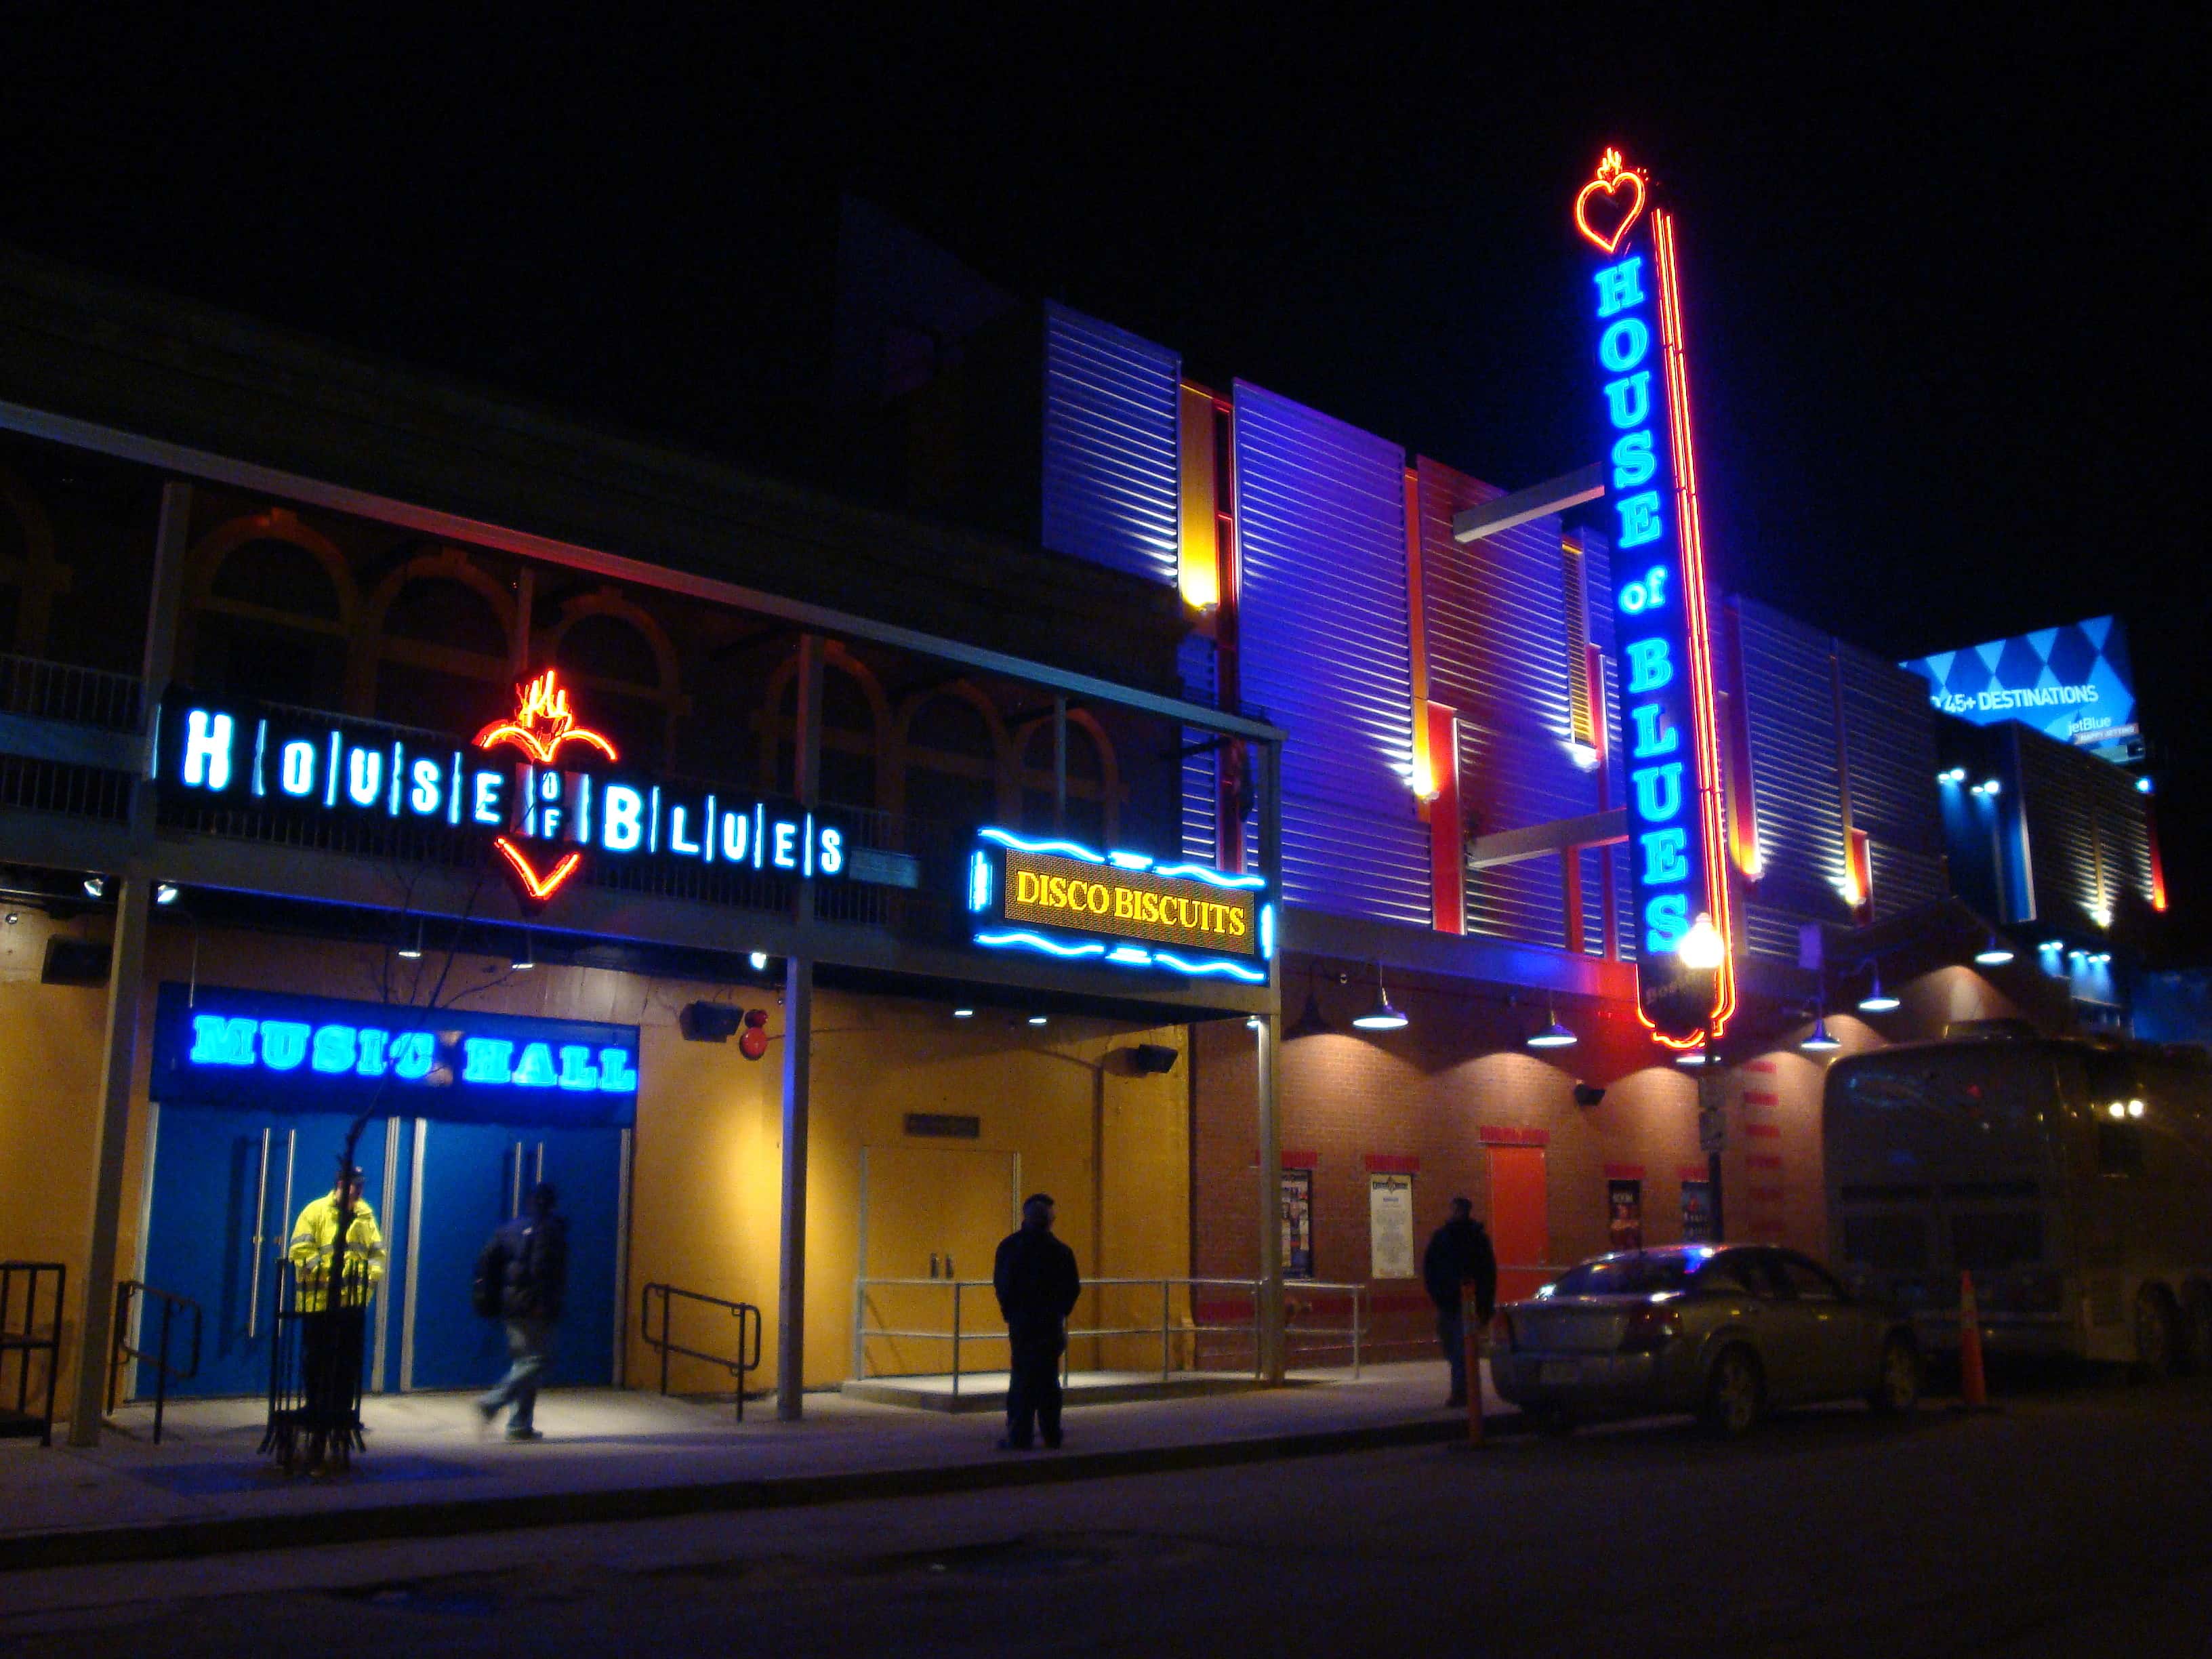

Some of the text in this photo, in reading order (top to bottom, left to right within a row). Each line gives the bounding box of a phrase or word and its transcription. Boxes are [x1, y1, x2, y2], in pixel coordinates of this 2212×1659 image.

[1593, 256, 1663, 548] HOUSE
[1619, 565, 1665, 612] of
[1978, 684, 2099, 712] DESTINATIONS
[182, 709, 843, 875] HOUSE OF BLUES
[1626, 636, 1692, 955] BLUES
[1016, 870, 1247, 937] DISCO BISCUITS
[190, 1014, 637, 1092] MUSIC HALL
